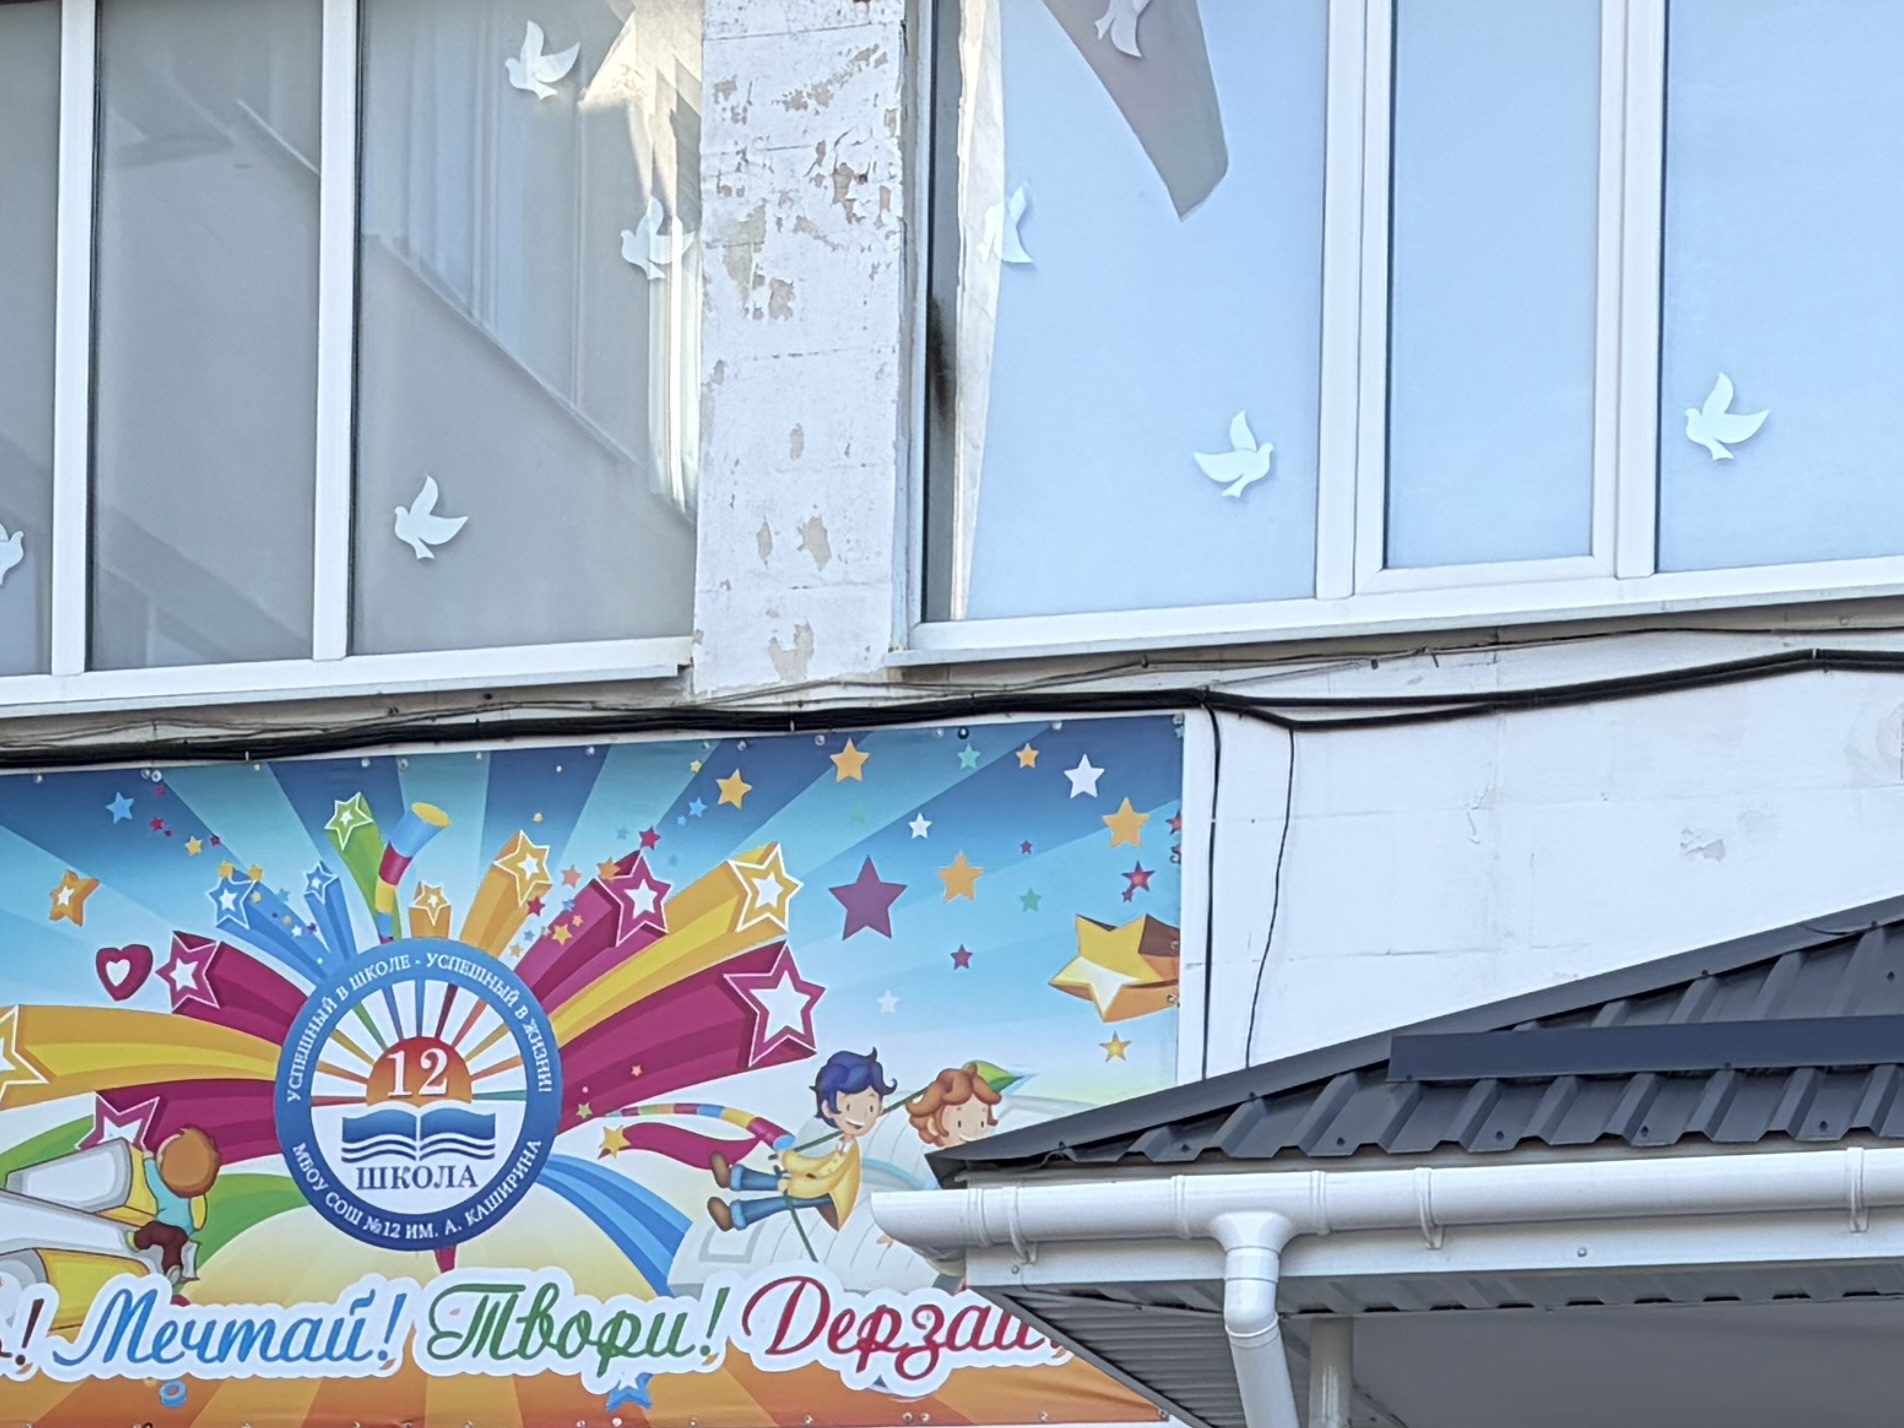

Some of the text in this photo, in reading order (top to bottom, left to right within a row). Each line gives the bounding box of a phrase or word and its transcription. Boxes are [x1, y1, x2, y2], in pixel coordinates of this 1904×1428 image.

[287, 997, 337, 1102] УСПЕШНЫЙ
[337, 987, 349, 1002] В
[349, 954, 411, 990] ШКОЛЕ
[425, 952, 520, 1009] УСПЕШНЫЙ
[514, 1006, 527, 1020] В
[386, 1046, 449, 1097] 12
[292, 1139, 543, 1240] МБОУ СОШ №12 ИМ. А. КАШИРИНА
[355, 1163, 480, 1191] ШКОЛА
[52, 1288, 408, 1367] Мечтай!
[427, 1281, 731, 1377] Твори!
